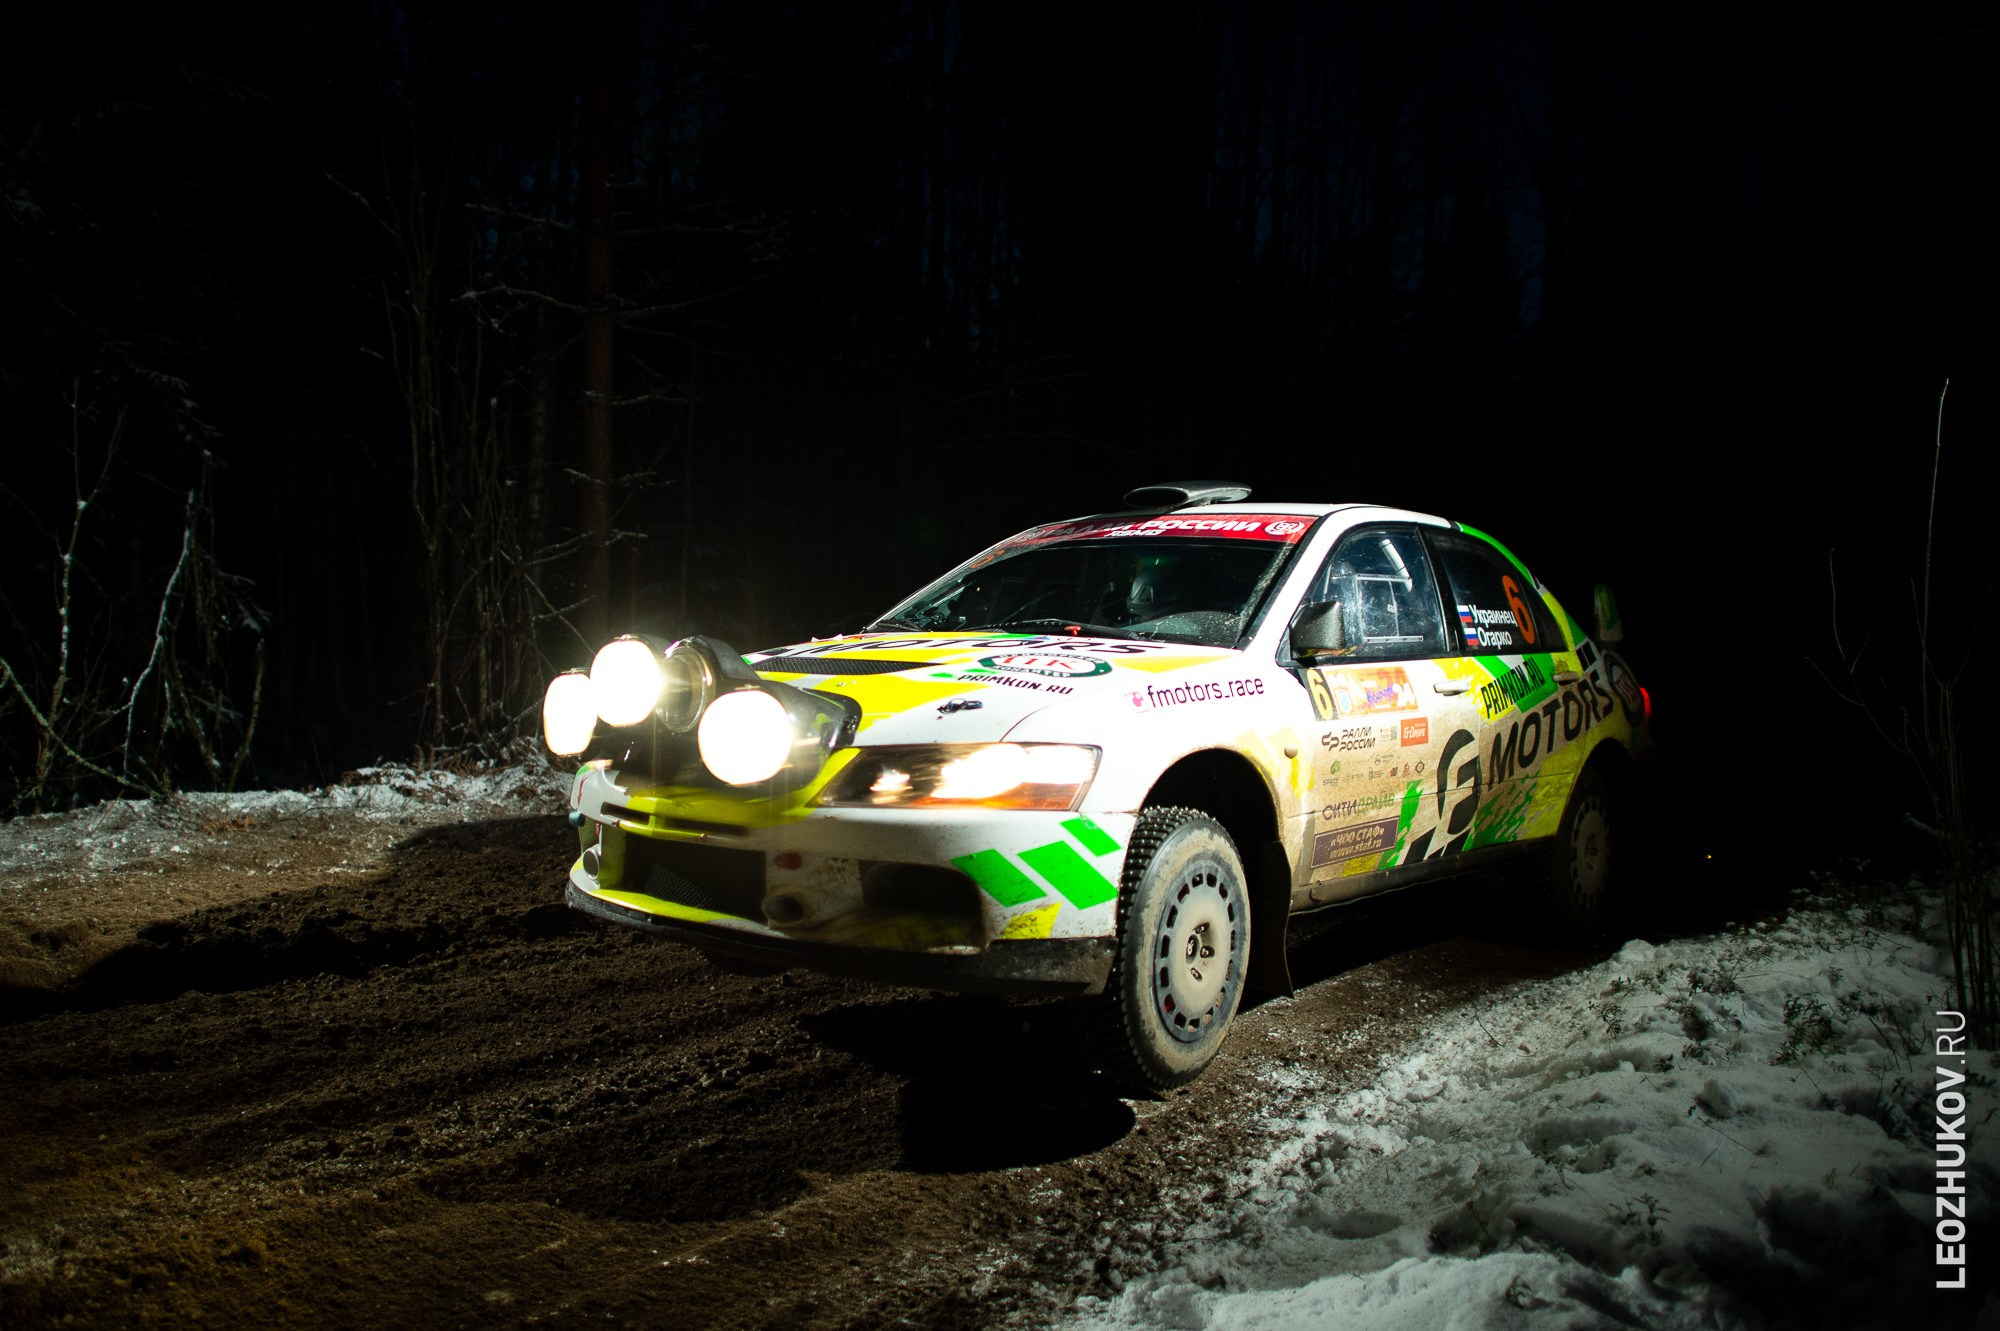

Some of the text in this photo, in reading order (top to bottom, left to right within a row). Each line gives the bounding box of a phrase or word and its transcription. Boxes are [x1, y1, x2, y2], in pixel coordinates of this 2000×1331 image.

[1139, 518, 1262, 531] РОССИИ
[1468, 604, 1518, 628] Украинец
[1502, 574, 1535, 644] 6
[786, 639, 1168, 655] MOTORS
[1477, 627, 1513, 649] Огарко
[958, 674, 1074, 696] PRIMKON.RU
[1147, 678, 1265, 708] fmotors_race
[1306, 669, 1333, 721] 6
[1481, 656, 1546, 719] PRIMKON.RU
[1341, 726, 1373, 740] РАЛЛИ
[1339, 737, 1376, 752] РОССИИ
